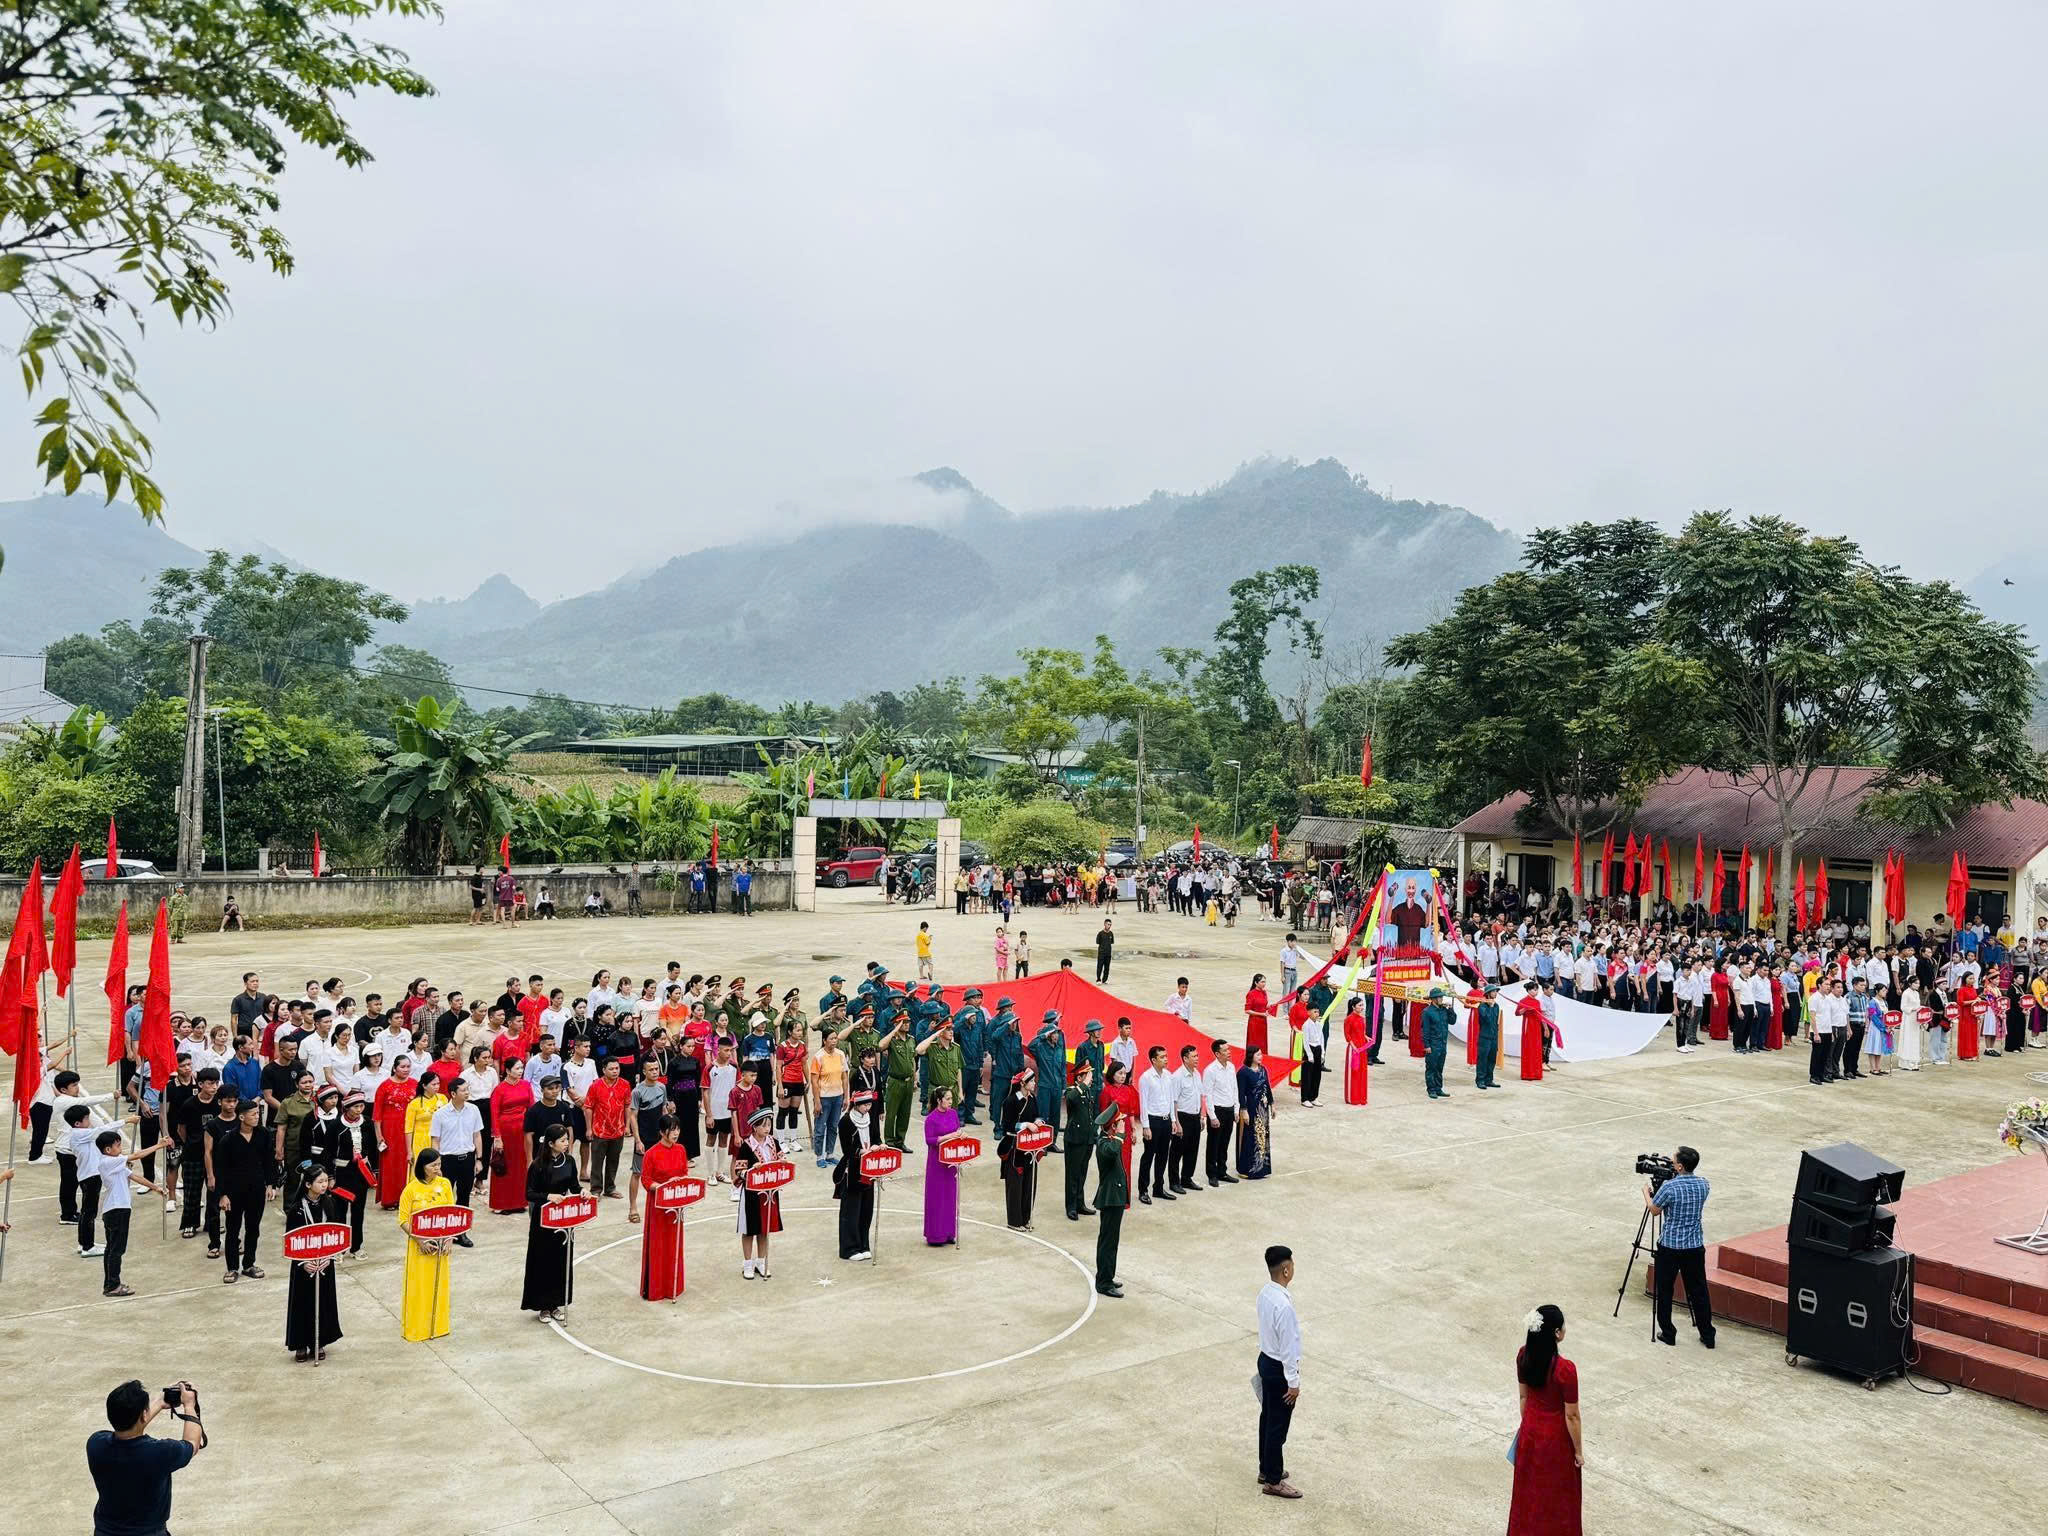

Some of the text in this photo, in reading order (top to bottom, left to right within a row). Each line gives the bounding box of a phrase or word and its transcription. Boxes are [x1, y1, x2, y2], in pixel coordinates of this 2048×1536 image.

[418, 1215, 431, 1229] Thôn
[462, 1212, 467, 1227] A
[548, 1206, 563, 1221] Thôn
[563, 1204, 578, 1219] Minh
[290, 1235, 306, 1251] Thôn
